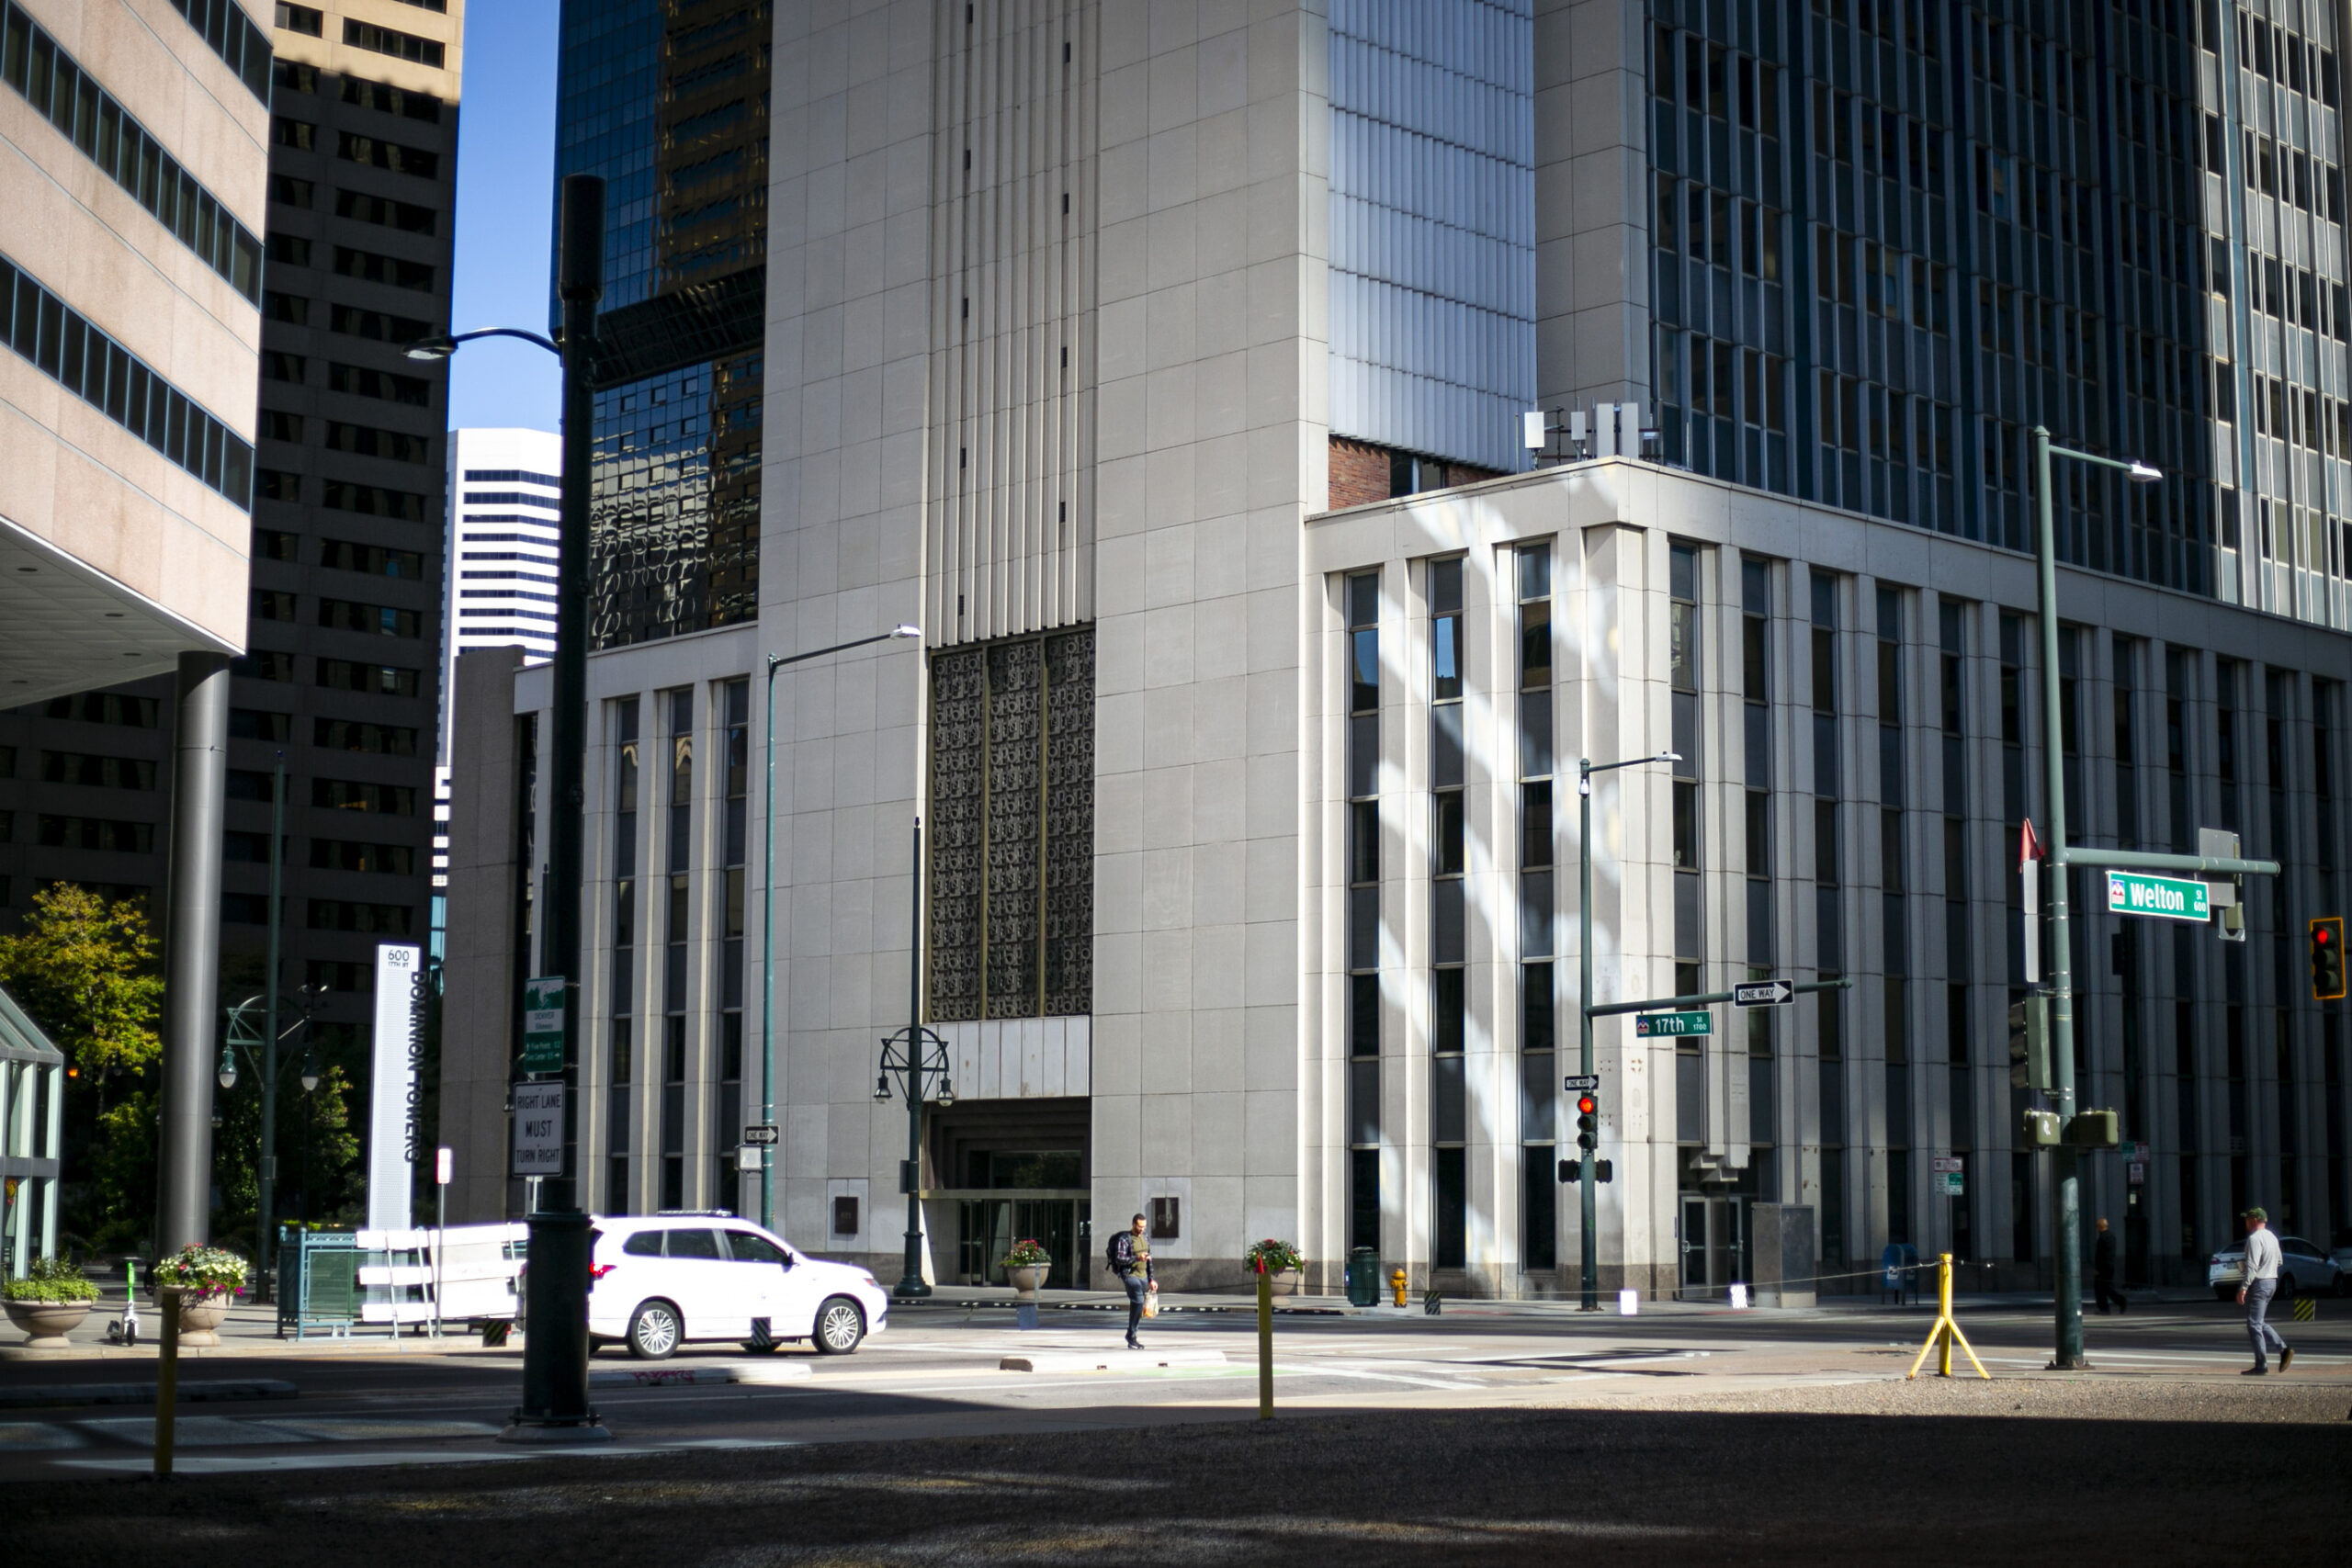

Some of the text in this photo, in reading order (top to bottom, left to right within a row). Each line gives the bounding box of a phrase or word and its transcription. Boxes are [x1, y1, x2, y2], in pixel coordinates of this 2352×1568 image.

[2131, 883, 2185, 911] Welton
[388, 950, 410, 962] 600
[1740, 988, 1775, 1000] ONE WAY
[408, 971, 426, 1071] DOMINION
[1656, 1017, 1685, 1033] 17th
[517, 1094, 560, 1110] RIGHT LANE
[404, 1077, 423, 1163] TOWERS
[526, 1120, 552, 1138] MUST
[516, 1148, 560, 1164] TURN RIGHT
